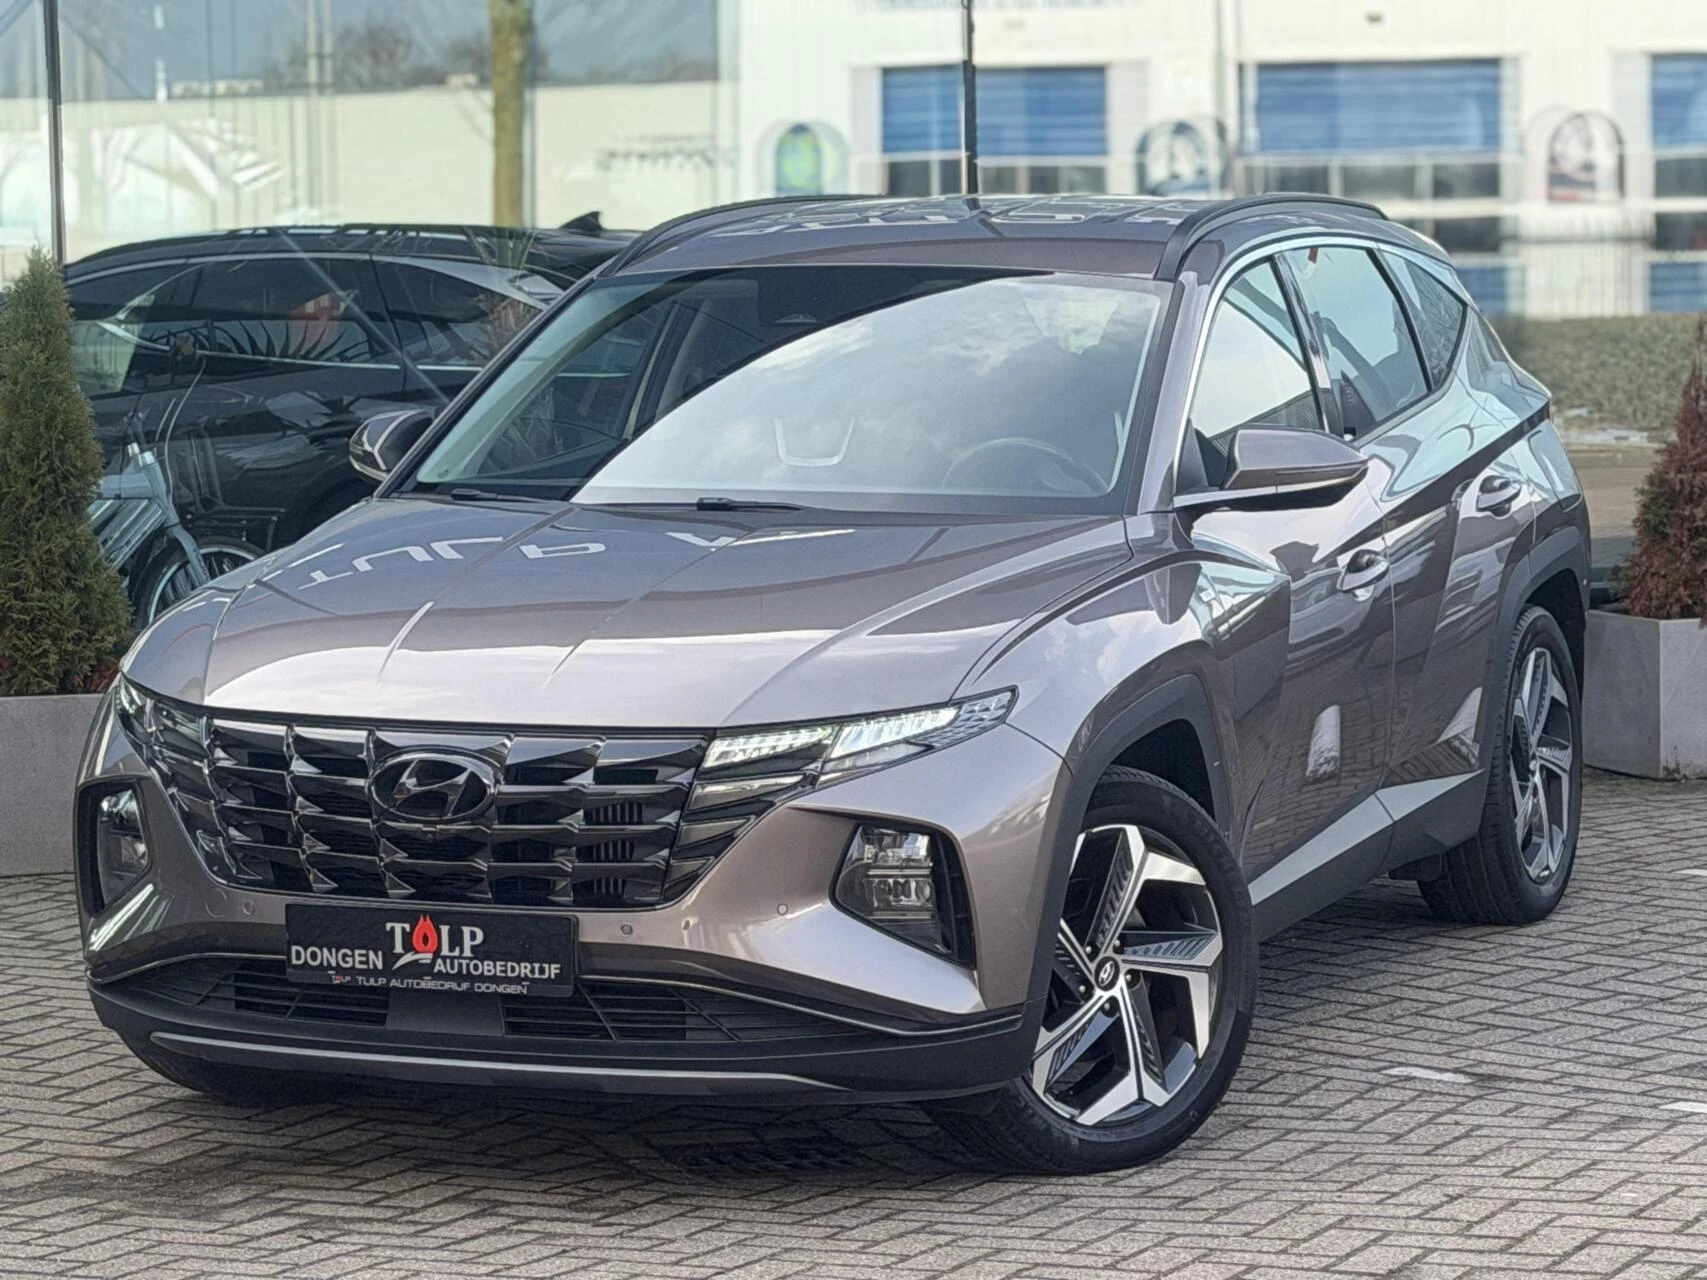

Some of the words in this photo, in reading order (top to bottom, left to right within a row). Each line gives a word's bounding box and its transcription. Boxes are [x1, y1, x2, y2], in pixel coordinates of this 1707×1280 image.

[290, 945, 383, 970] DONGEN
[433, 958, 561, 980] AUTOBEDRIJF
[356, 975, 387, 987] TULP
[474, 982, 528, 994] DONGEN
